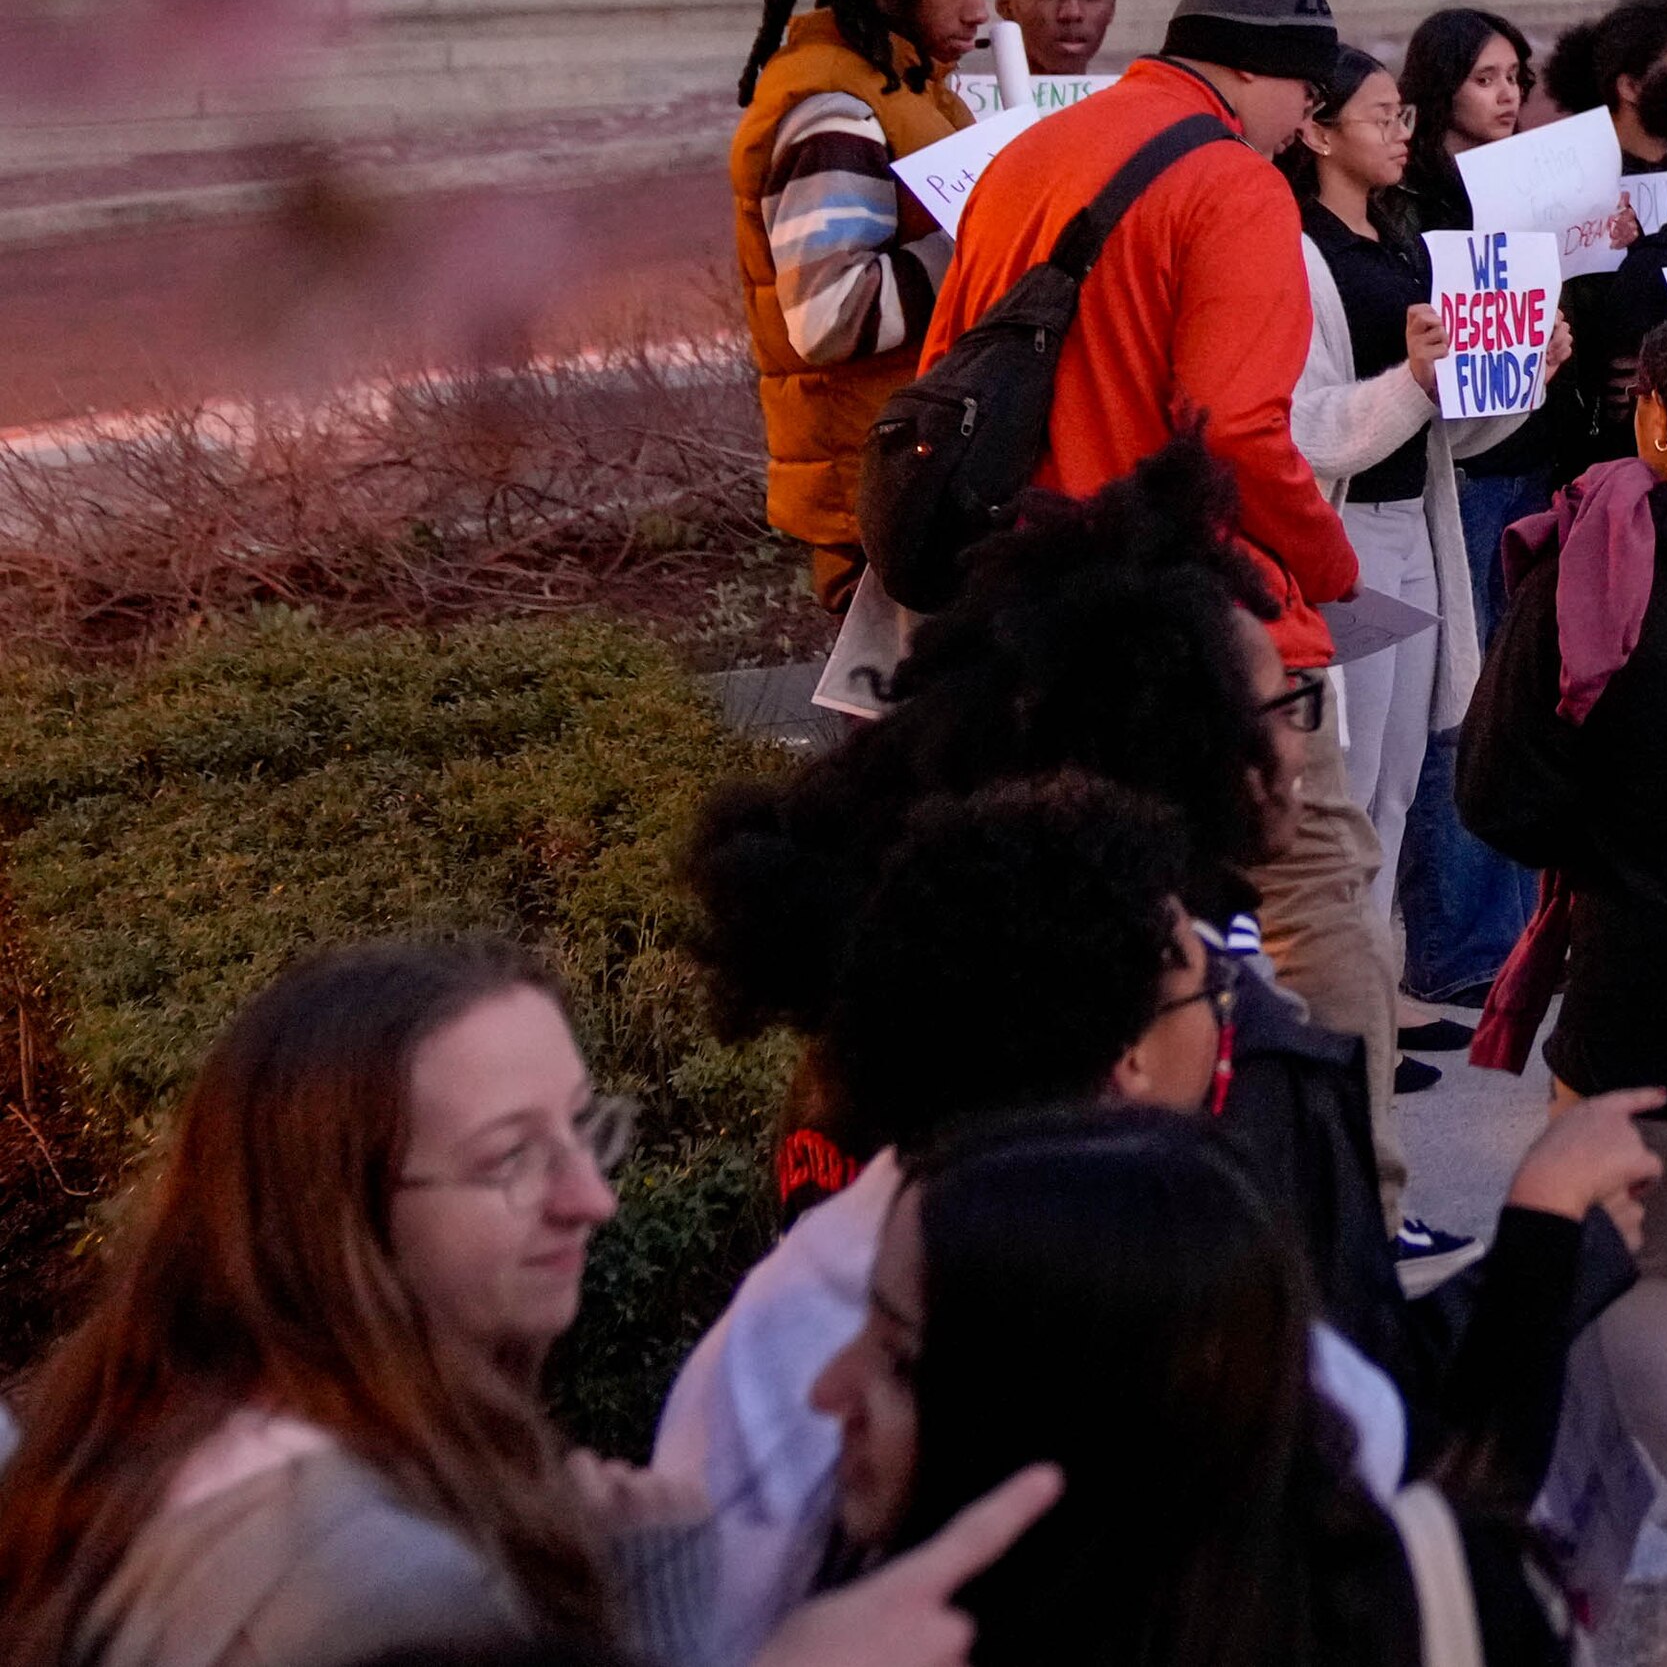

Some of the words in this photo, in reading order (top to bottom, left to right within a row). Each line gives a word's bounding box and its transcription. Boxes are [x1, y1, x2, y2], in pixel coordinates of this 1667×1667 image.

[926, 168, 977, 204] Put
[1467, 231, 1508, 291] WE
[1441, 288, 1546, 352] DESERVE
